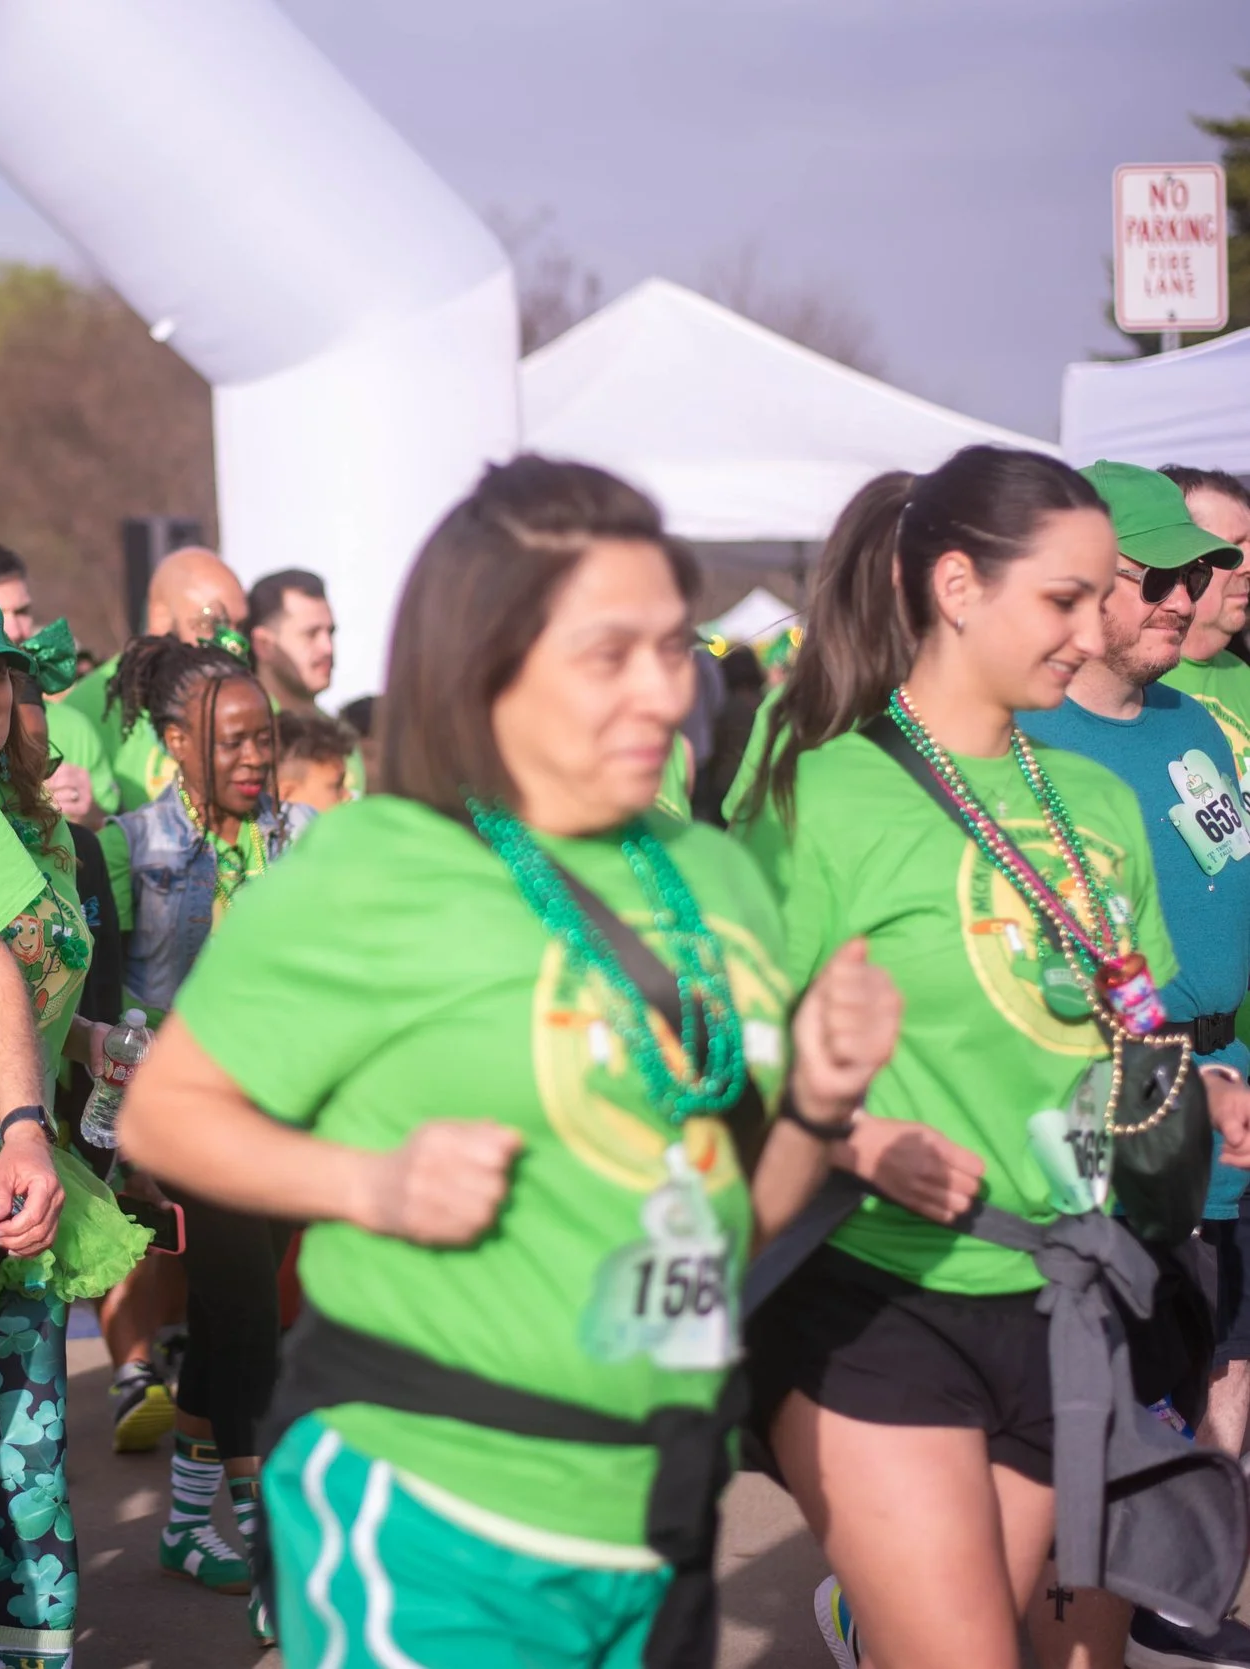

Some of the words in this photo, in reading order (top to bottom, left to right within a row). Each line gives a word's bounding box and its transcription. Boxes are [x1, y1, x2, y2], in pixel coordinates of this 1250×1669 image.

[1149, 179, 1189, 211] NO
[1126, 214, 1216, 246] PARKING
[1148, 252, 1191, 270] FIRE
[1144, 275, 1196, 297] LANE
[1195, 793, 1242, 843] 653
